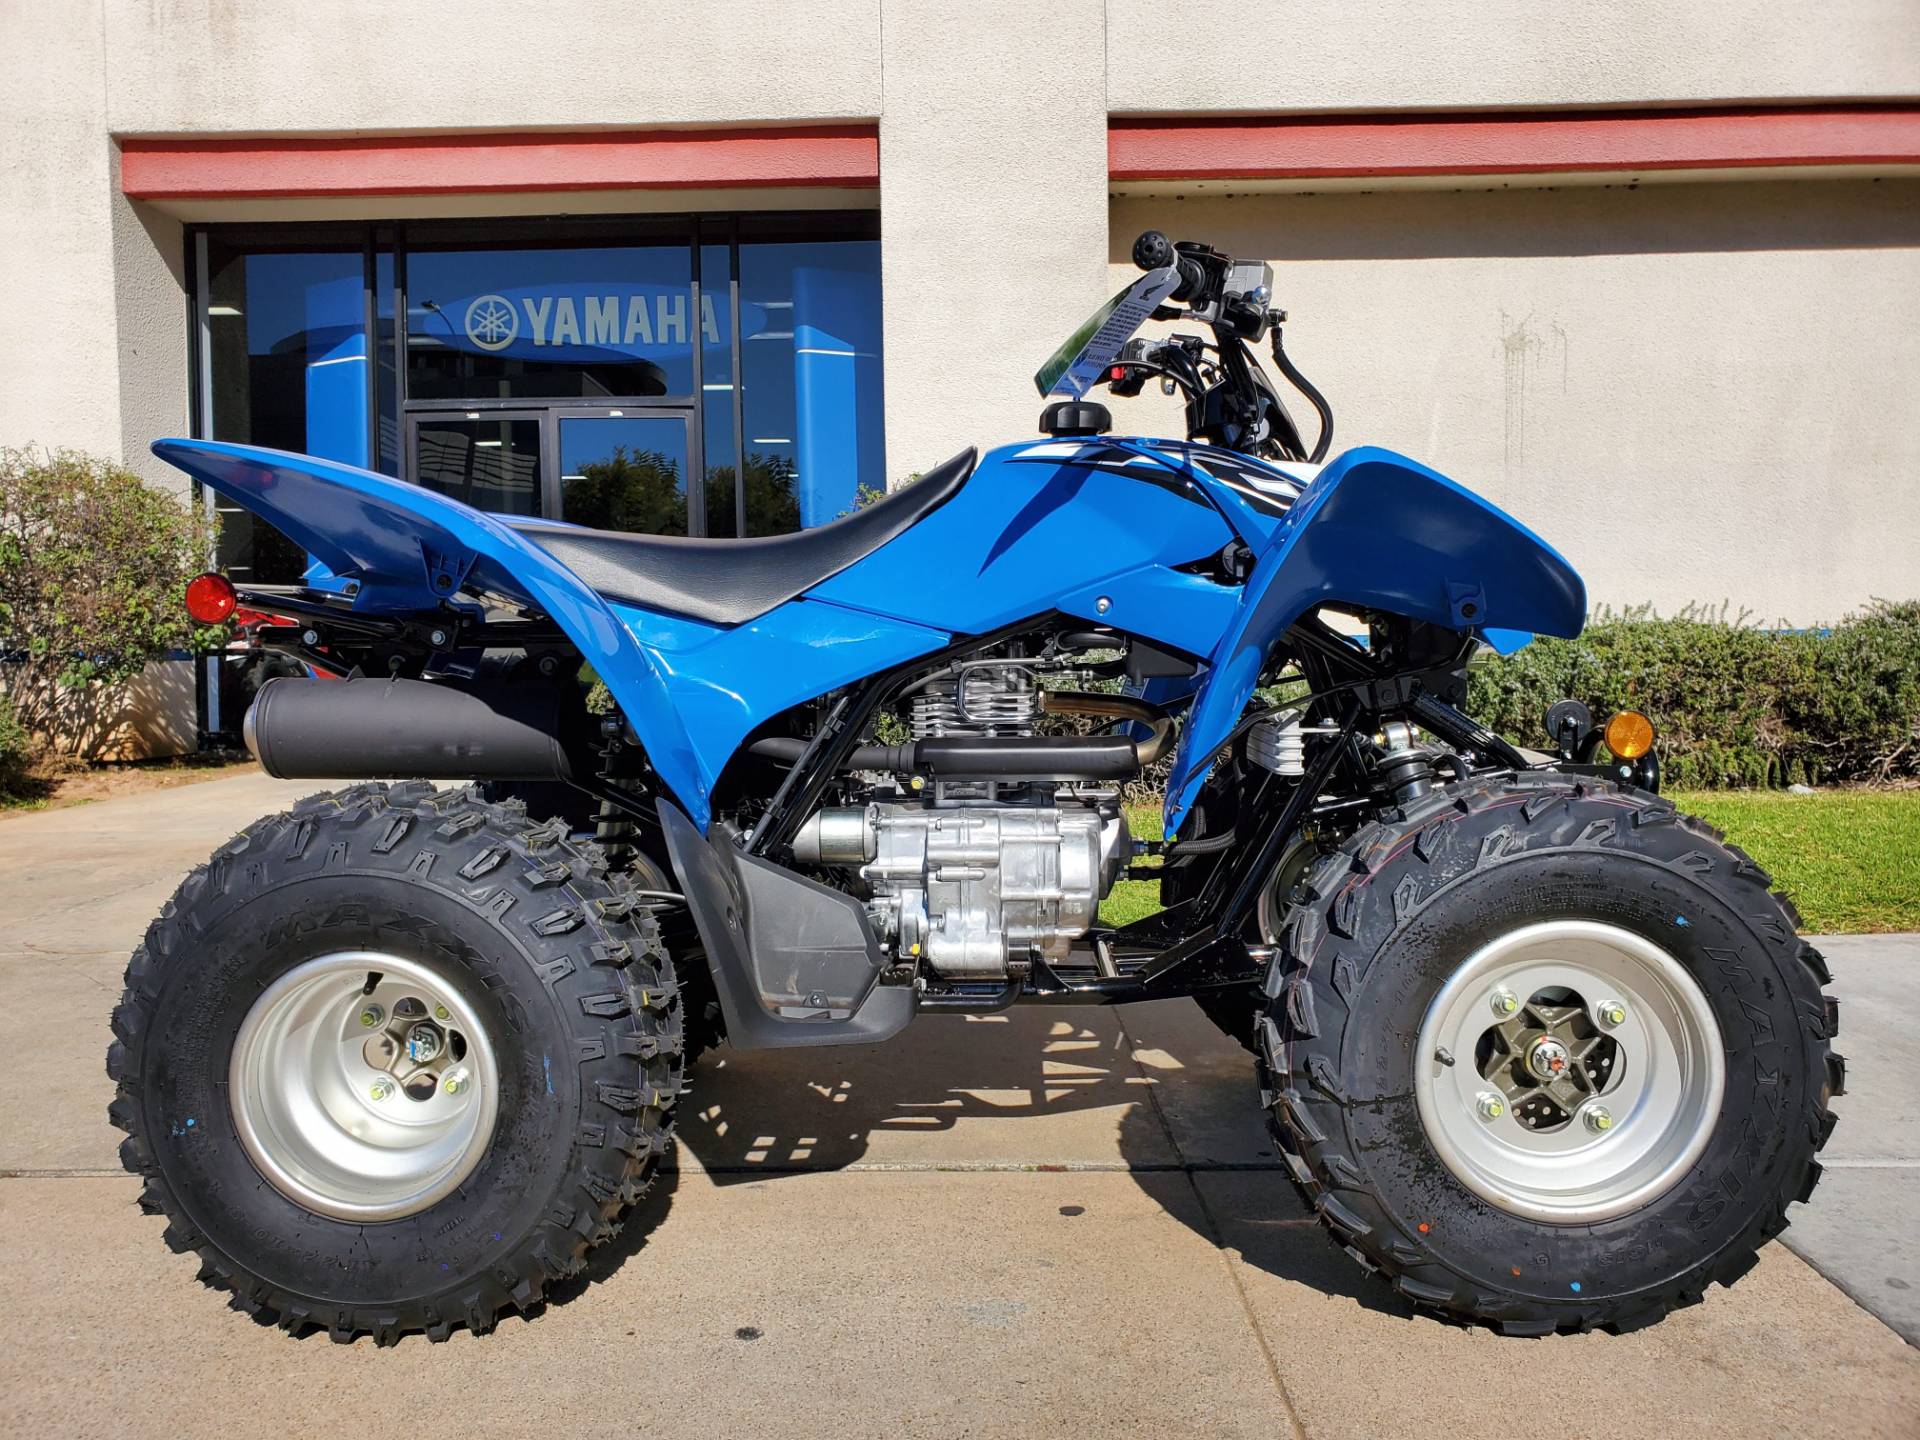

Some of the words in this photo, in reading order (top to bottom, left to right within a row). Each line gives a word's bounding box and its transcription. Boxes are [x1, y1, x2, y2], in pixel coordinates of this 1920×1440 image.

[522, 294, 720, 345] YAMAHA
[265, 903, 529, 1033] MAXXIS
[1686, 945, 1780, 1231] MAXXIS
